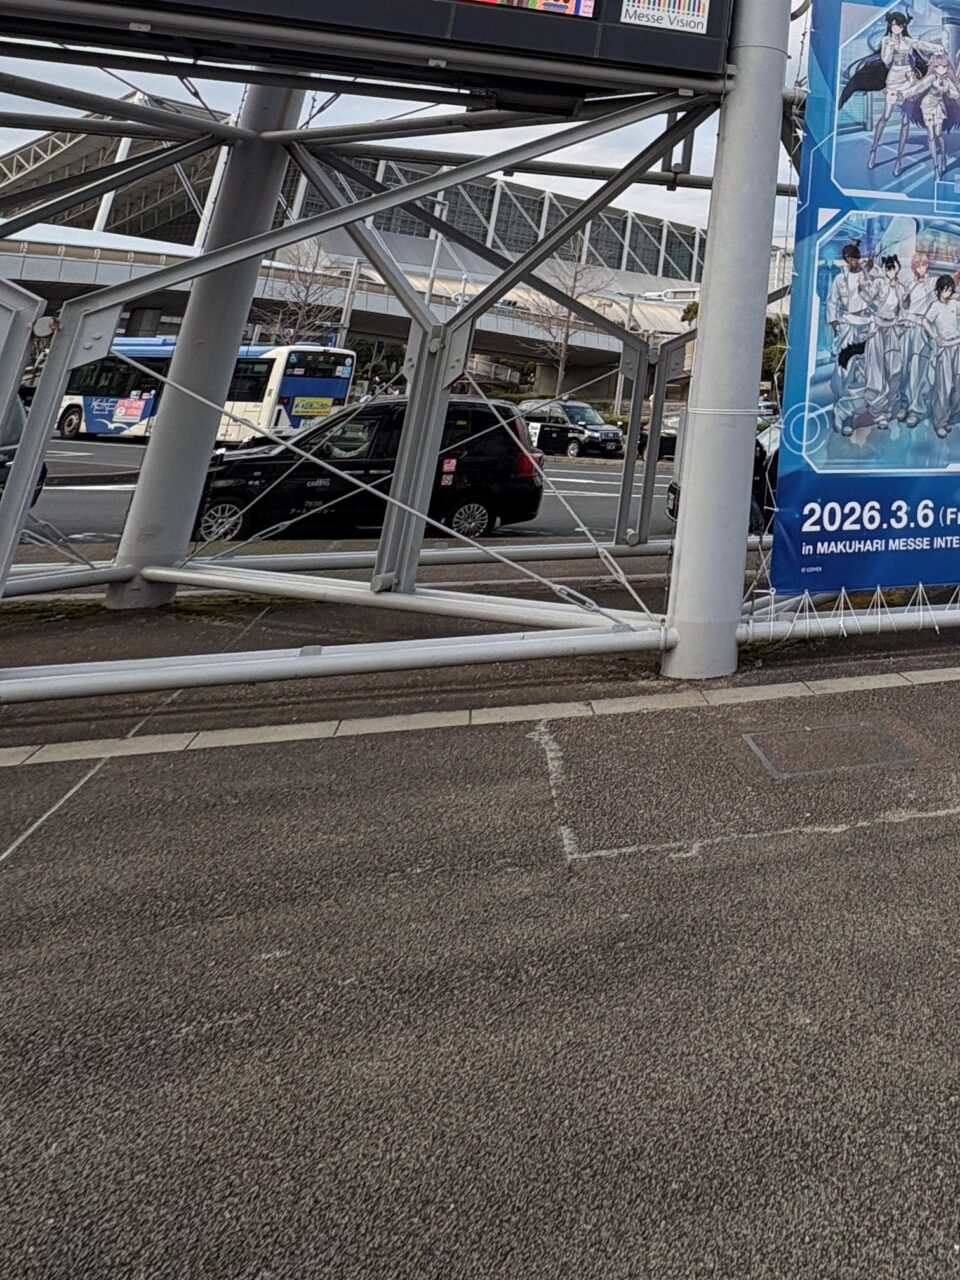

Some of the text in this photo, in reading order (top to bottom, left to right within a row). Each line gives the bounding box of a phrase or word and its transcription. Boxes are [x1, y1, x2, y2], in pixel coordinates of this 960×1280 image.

[624, 8, 705, 31] Messe Vision
[801, 499, 935, 532] 2026.3.6
[802, 541, 813, 555] in
[816, 539, 885, 554] MAKUHARI
[888, 536, 931, 551] MESSE
